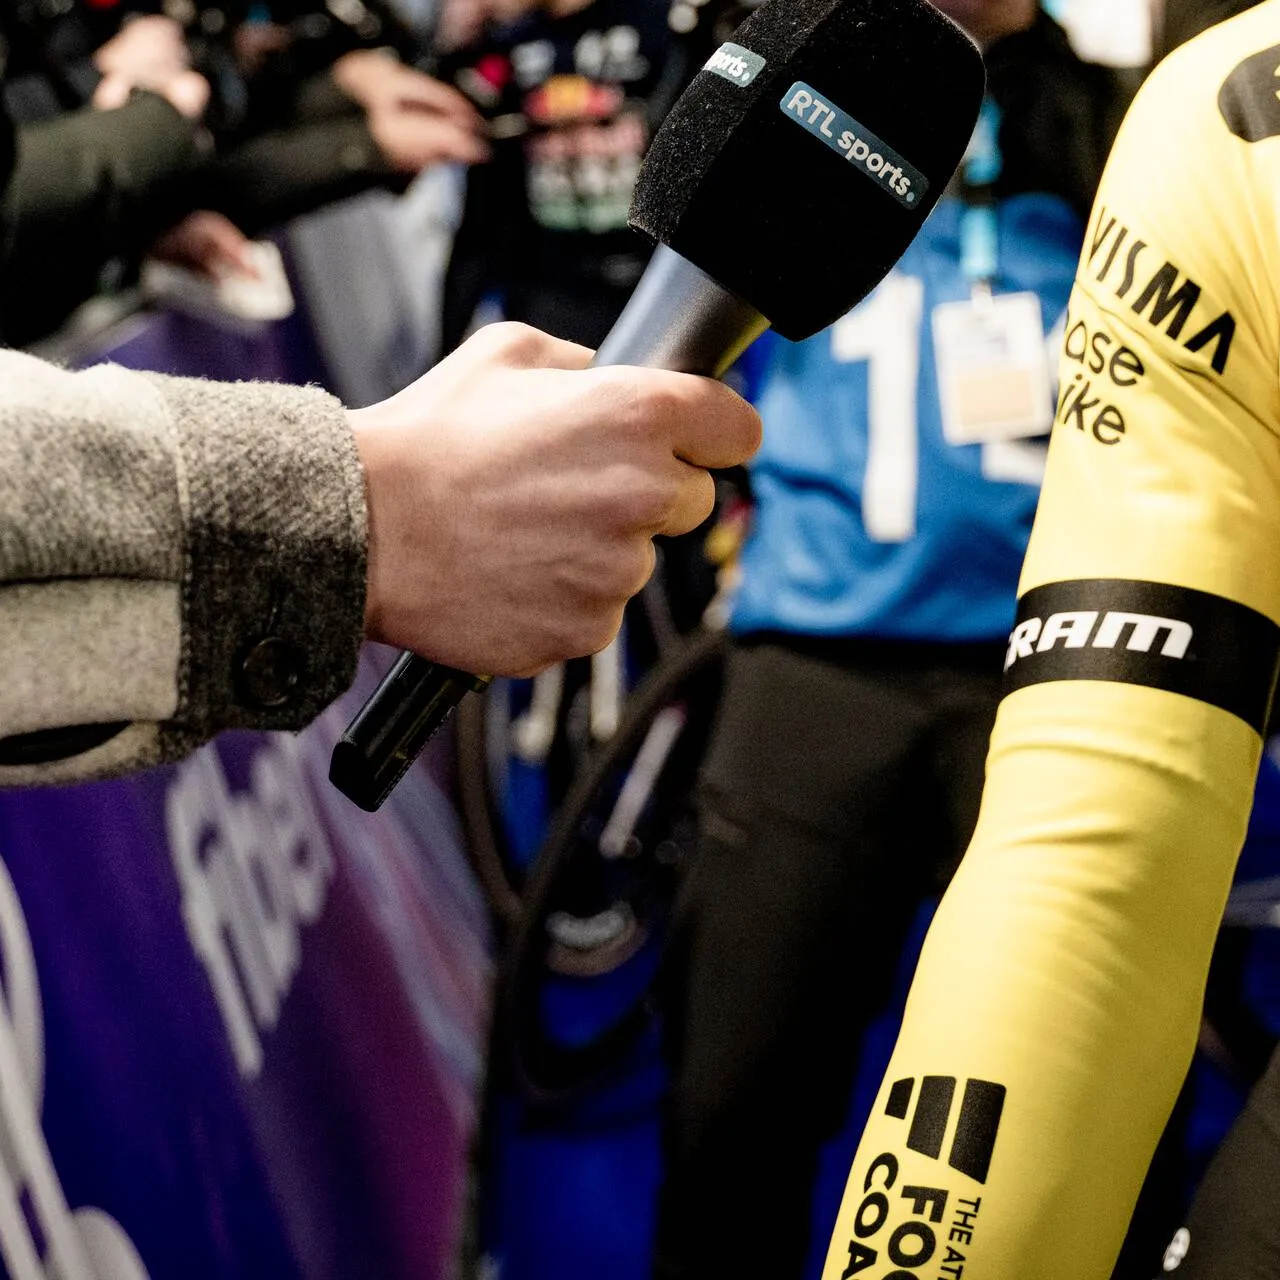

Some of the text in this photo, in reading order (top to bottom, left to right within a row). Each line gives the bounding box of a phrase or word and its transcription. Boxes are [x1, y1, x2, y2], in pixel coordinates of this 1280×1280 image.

[786, 89, 835, 138] RTL
[1003, 610, 1194, 673] RAM
[840, 1152, 899, 1280] COA
[947, 1196, 982, 1246] THE
